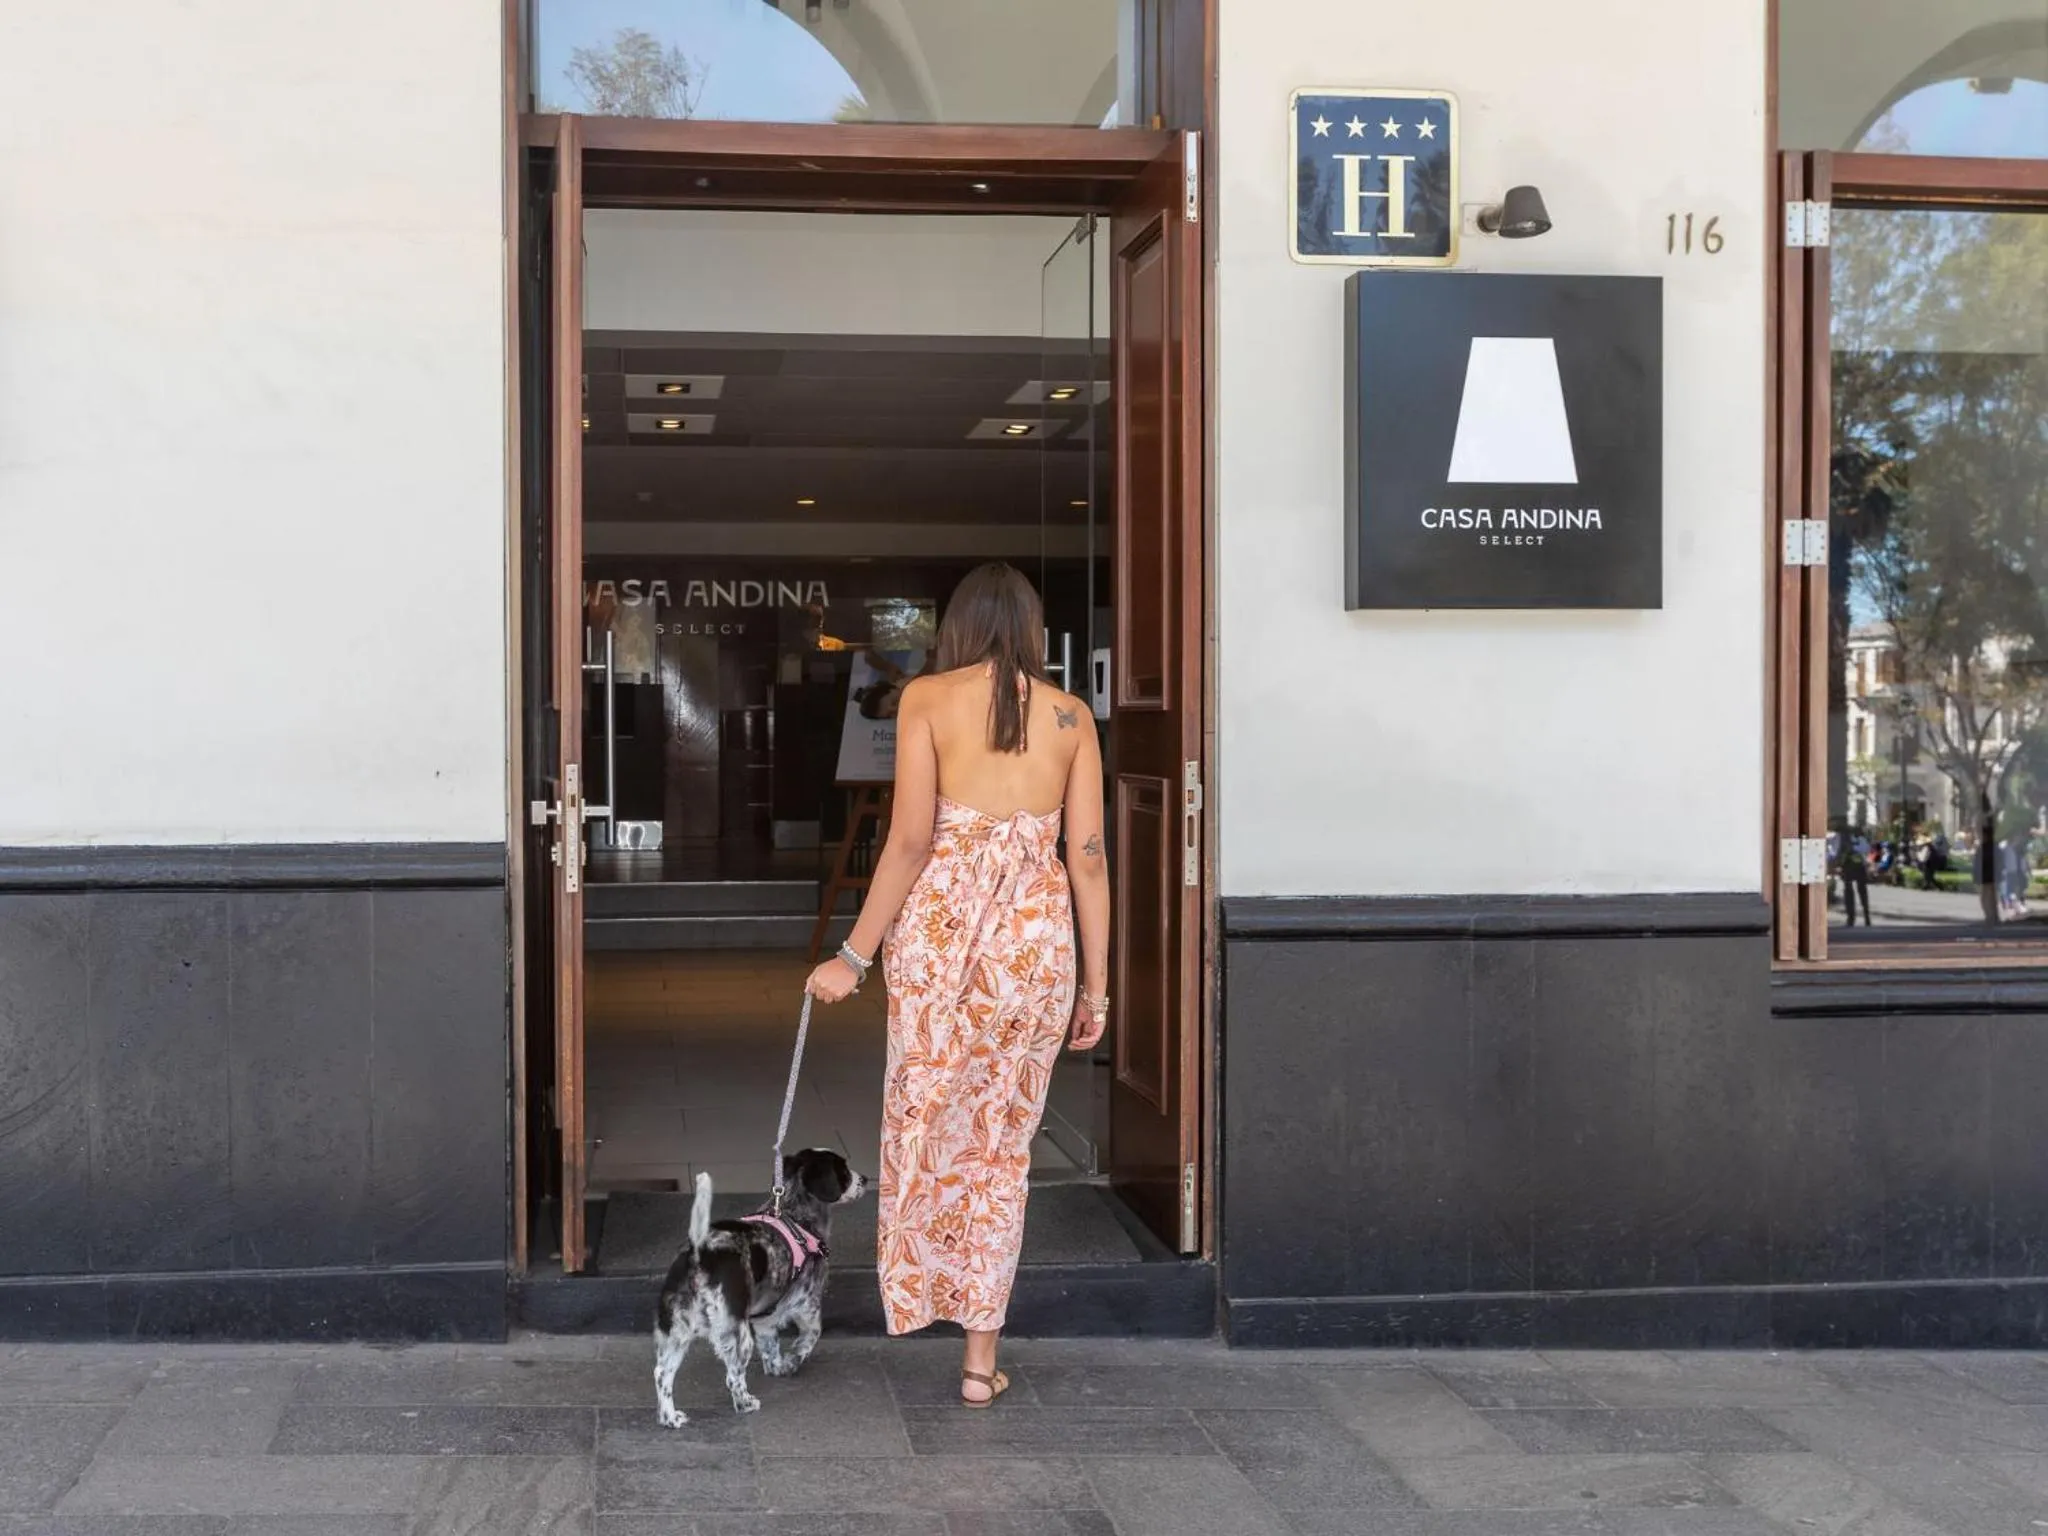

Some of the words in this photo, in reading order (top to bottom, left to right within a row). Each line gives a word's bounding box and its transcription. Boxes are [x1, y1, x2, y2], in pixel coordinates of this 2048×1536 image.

[1332, 154, 1416, 238] H
[1667, 212, 1724, 255] 116
[1421, 508, 1493, 529] CASA
[1501, 509, 1602, 529] ANDINA
[1480, 536, 1544, 545] SELECT
[684, 580, 829, 607] ANDINA
[655, 623, 745, 635] SELECT
